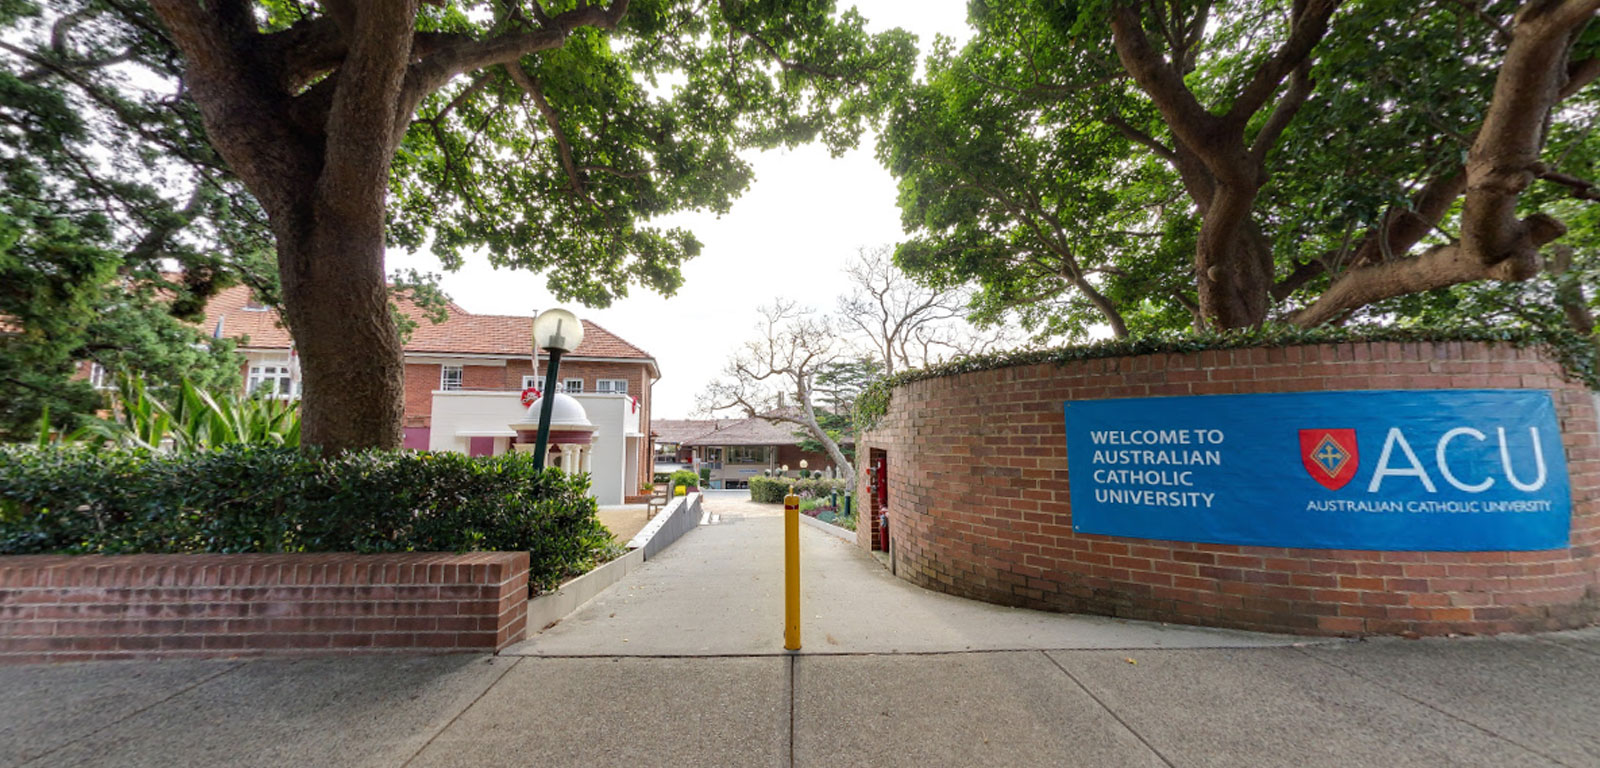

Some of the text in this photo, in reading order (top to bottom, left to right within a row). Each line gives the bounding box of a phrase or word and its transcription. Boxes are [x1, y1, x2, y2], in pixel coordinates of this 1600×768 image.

[1090, 429, 1224, 445] WELCOME TO
[1093, 450, 1221, 465] AUSTRALIAN
[1367, 426, 1548, 493] ACU
[1093, 469, 1193, 486] CATHOLIC
[1095, 489, 1215, 508] UNIVERSITY
[1306, 500, 1552, 513] AUSTRALIAN CATHOLIC UNIVERSITY
